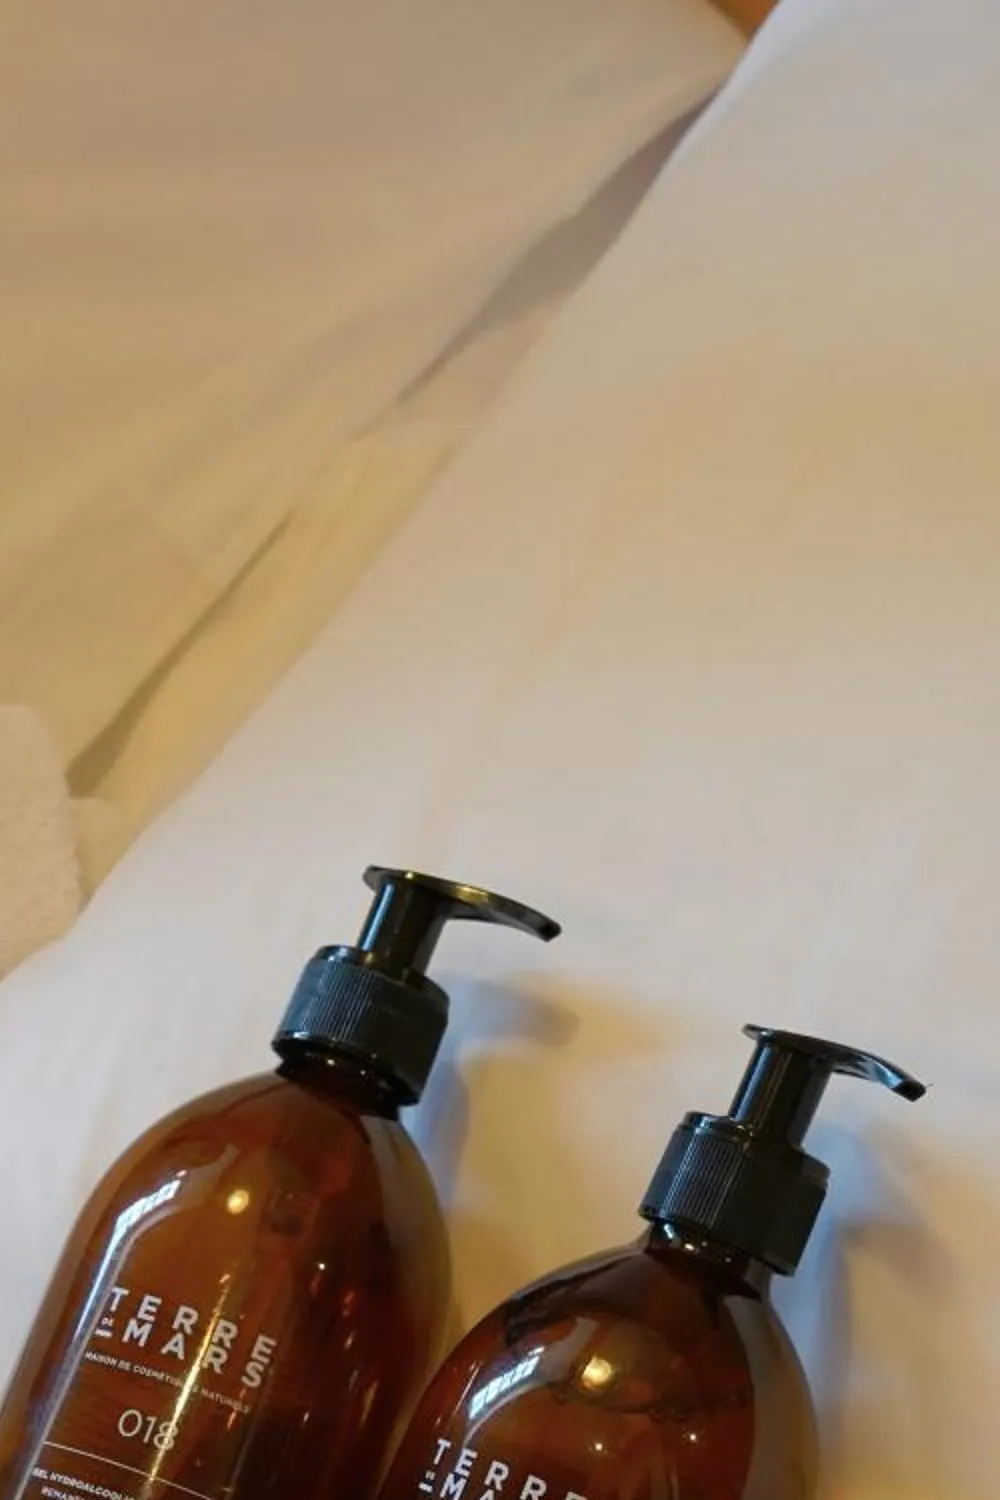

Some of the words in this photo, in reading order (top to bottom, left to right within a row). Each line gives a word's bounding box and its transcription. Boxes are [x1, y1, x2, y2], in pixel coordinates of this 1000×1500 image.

[110, 1285, 278, 1366] TERRE
[121, 1317, 265, 1388] MARS
[83, 1351, 117, 1366] MAISON
[118, 1360, 132, 1371] DE
[117, 1408, 179, 1451] 018
